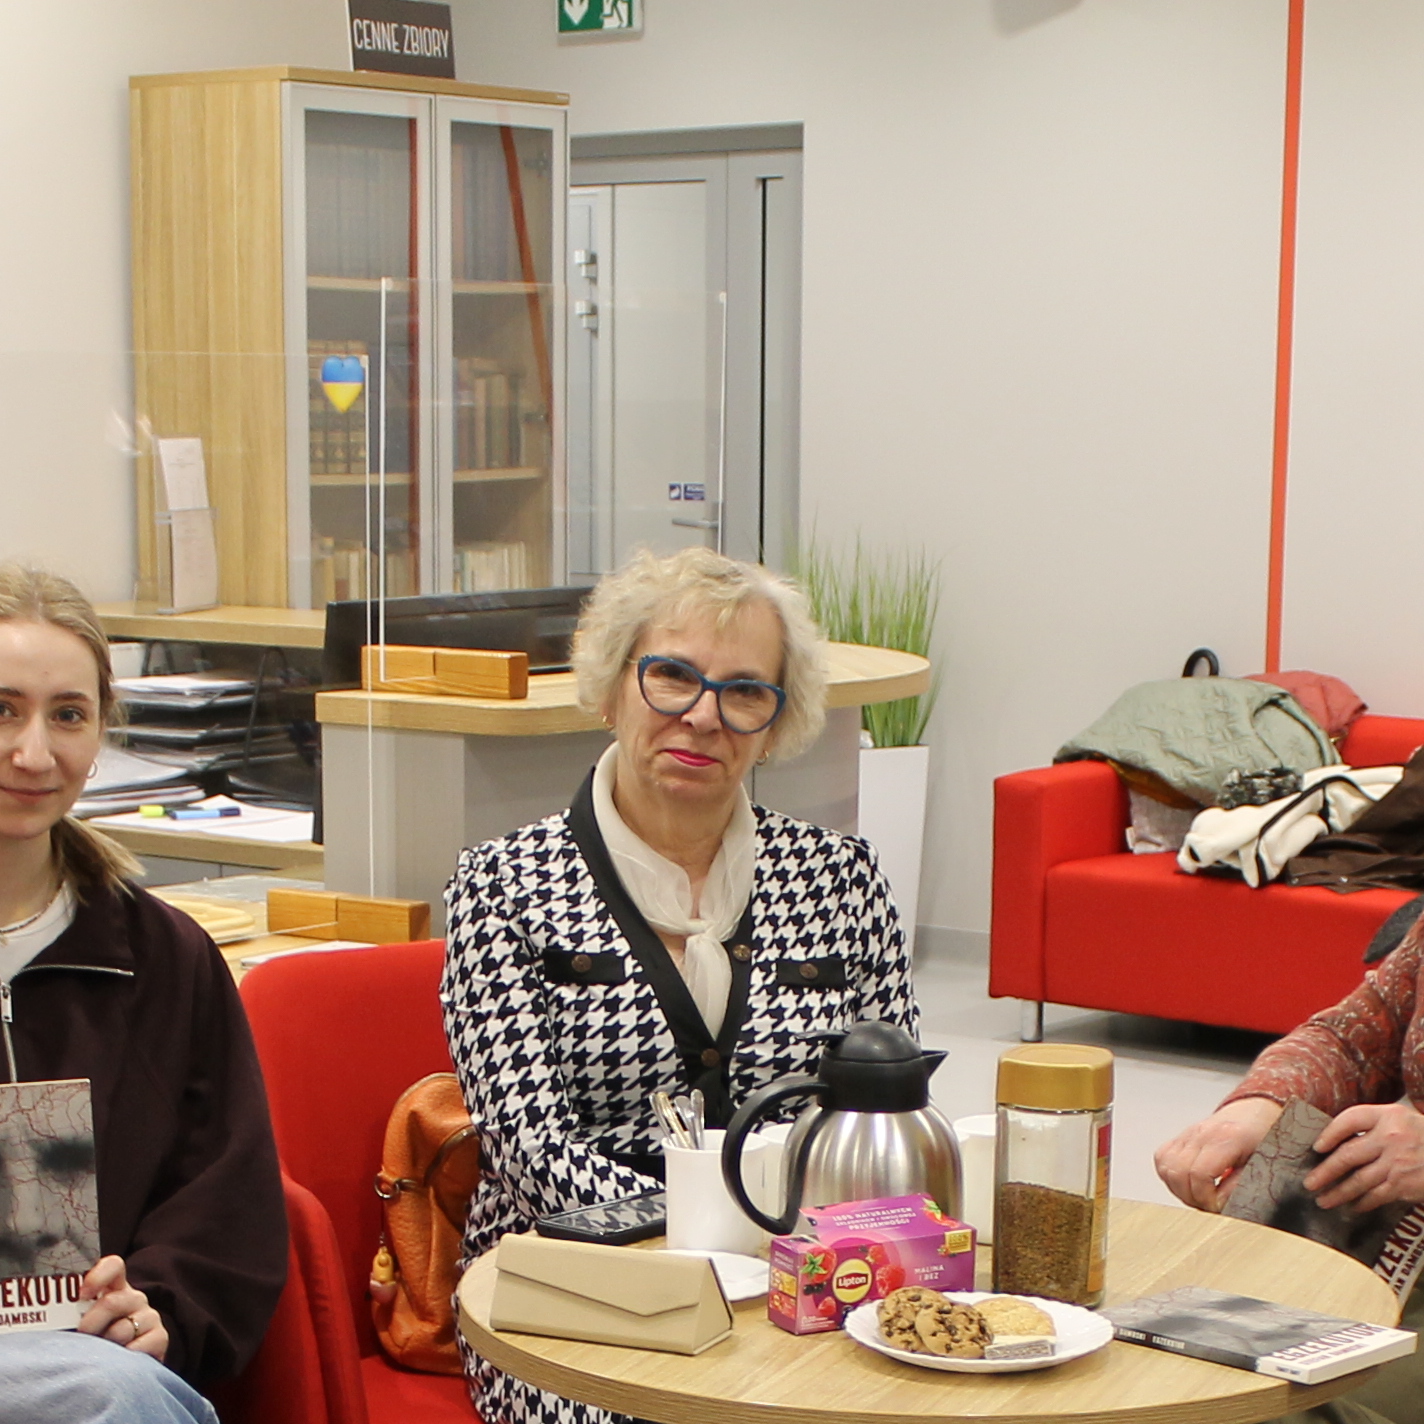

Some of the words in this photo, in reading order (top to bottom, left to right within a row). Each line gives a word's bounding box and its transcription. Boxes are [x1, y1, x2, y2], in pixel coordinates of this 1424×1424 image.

[352, 18, 401, 53] CENNE
[403, 24, 449, 58] ZBIORY
[914, 1264, 945, 1275] MALINA
[838, 1274, 867, 1290] Lipton
